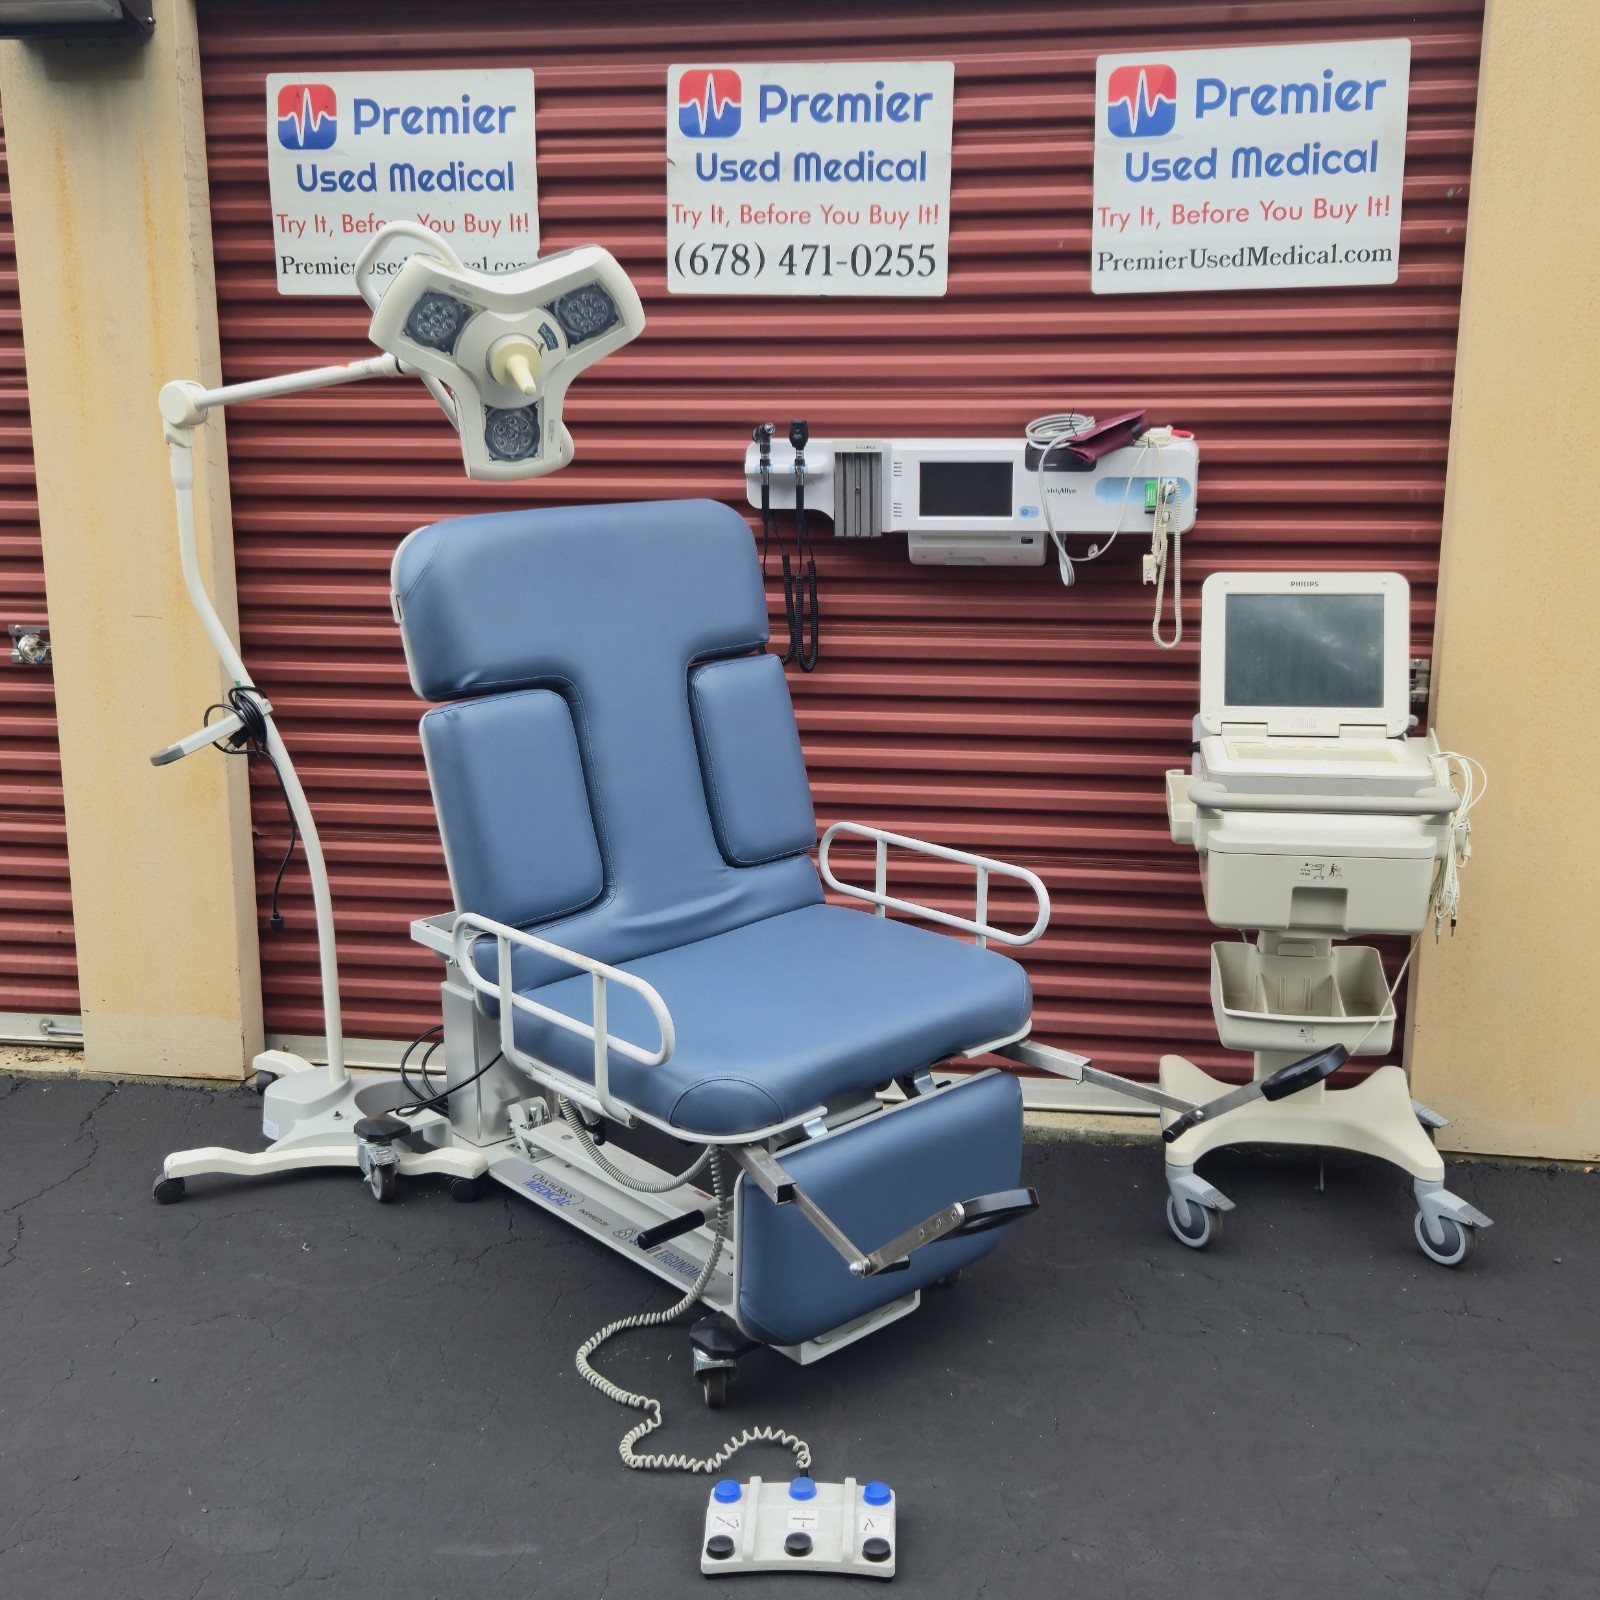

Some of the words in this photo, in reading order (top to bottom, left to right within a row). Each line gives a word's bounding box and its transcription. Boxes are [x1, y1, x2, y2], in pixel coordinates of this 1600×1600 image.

[759, 80, 934, 124] Premier
[1195, 68, 1388, 119] Premier
[353, 94, 517, 136] Premier
[296, 162, 378, 193] Used
[389, 160, 515, 193] Medical
[695, 151, 781, 182] Used
[793, 150, 927, 182] Medical
[1125, 147, 1218, 183] Used
[1231, 139, 1379, 179] Medical
[276, 213, 306, 238] Try
[314, 213, 334, 238] It,
[464, 213, 502, 238] Buy
[510, 212, 530, 233] It!
[672, 204, 702, 230] Try
[711, 204, 731, 229] It,
[740, 203, 812, 226] Before
[819, 204, 860, 226] You
[869, 203, 910, 230] Buy
[918, 203, 939, 225] It!
[1097, 206, 1131, 233] Try
[1140, 205, 1162, 230] It,
[1172, 201, 1250, 226] Before
[1259, 199, 1304, 222] You
[1313, 197, 1359, 225] Buy
[1366, 195, 1391, 217] It!
[674, 241, 766, 279] (678)
[778, 243, 937, 278] 471-0255
[1097, 244, 1393, 272] PremierUsedMedical.com
[522, 1180, 570, 1207] MEDICAL
